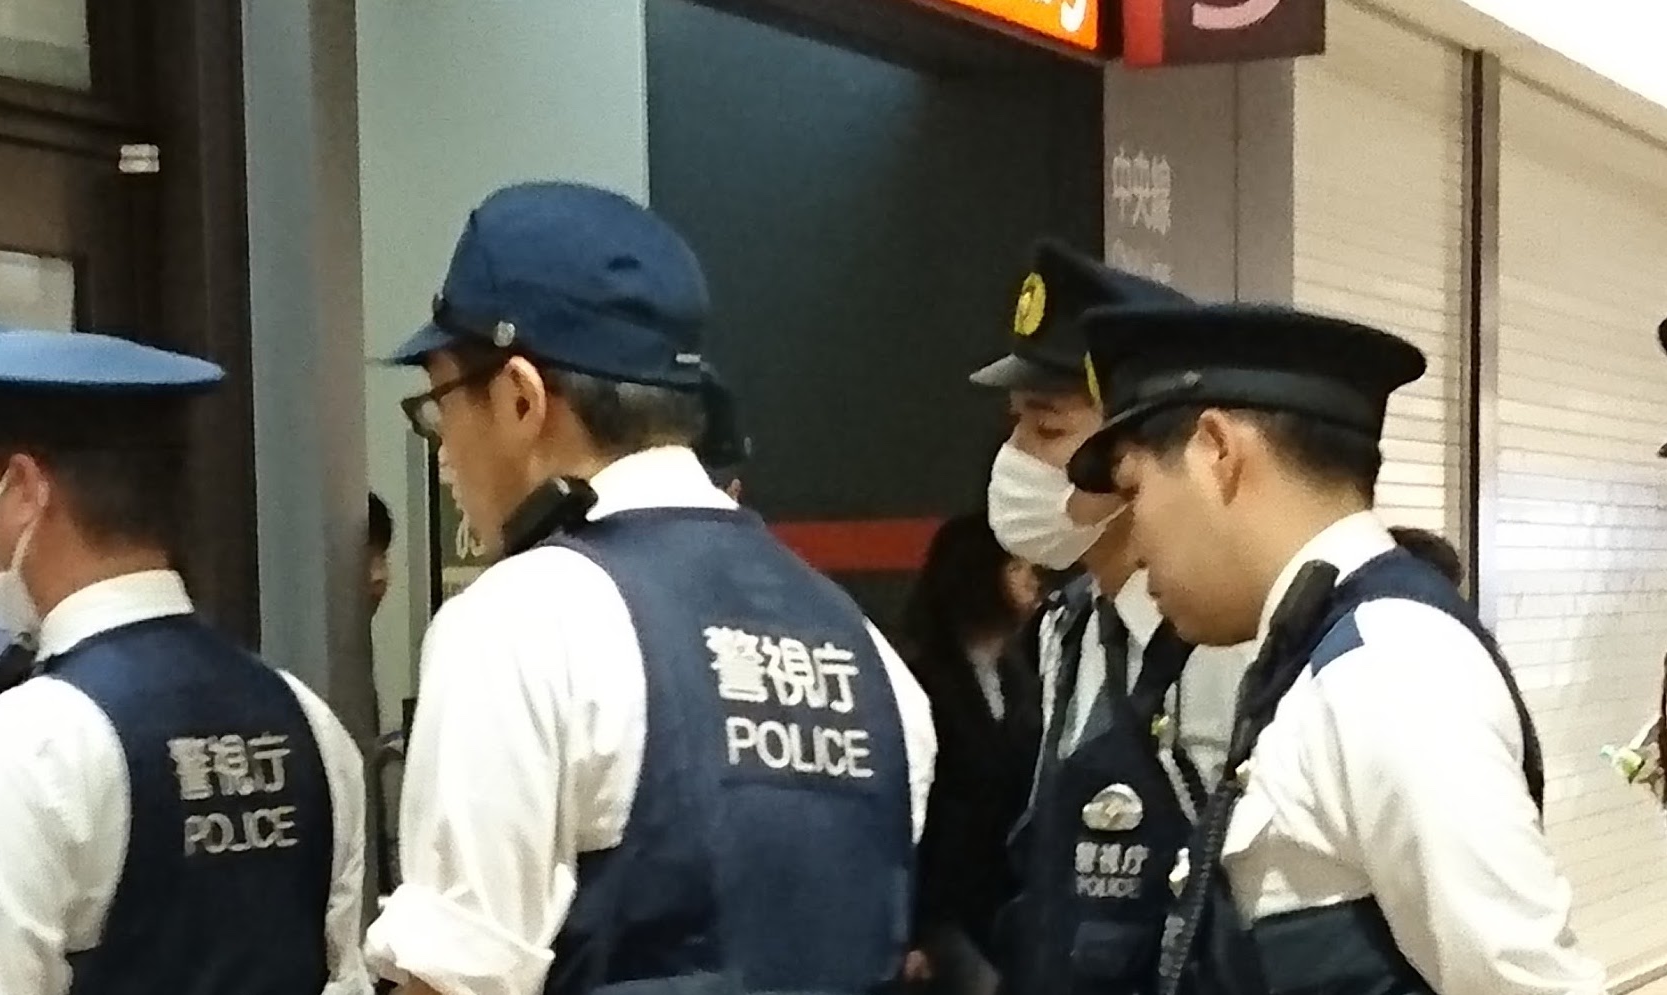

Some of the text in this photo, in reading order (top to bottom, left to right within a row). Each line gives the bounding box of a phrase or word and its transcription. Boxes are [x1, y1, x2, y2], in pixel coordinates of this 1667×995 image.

[703, 625, 859, 713] 警視庁
[166, 731, 291, 800] 警視庁
[725, 716, 874, 777] POLICE
[184, 805, 299, 857] POLICE
